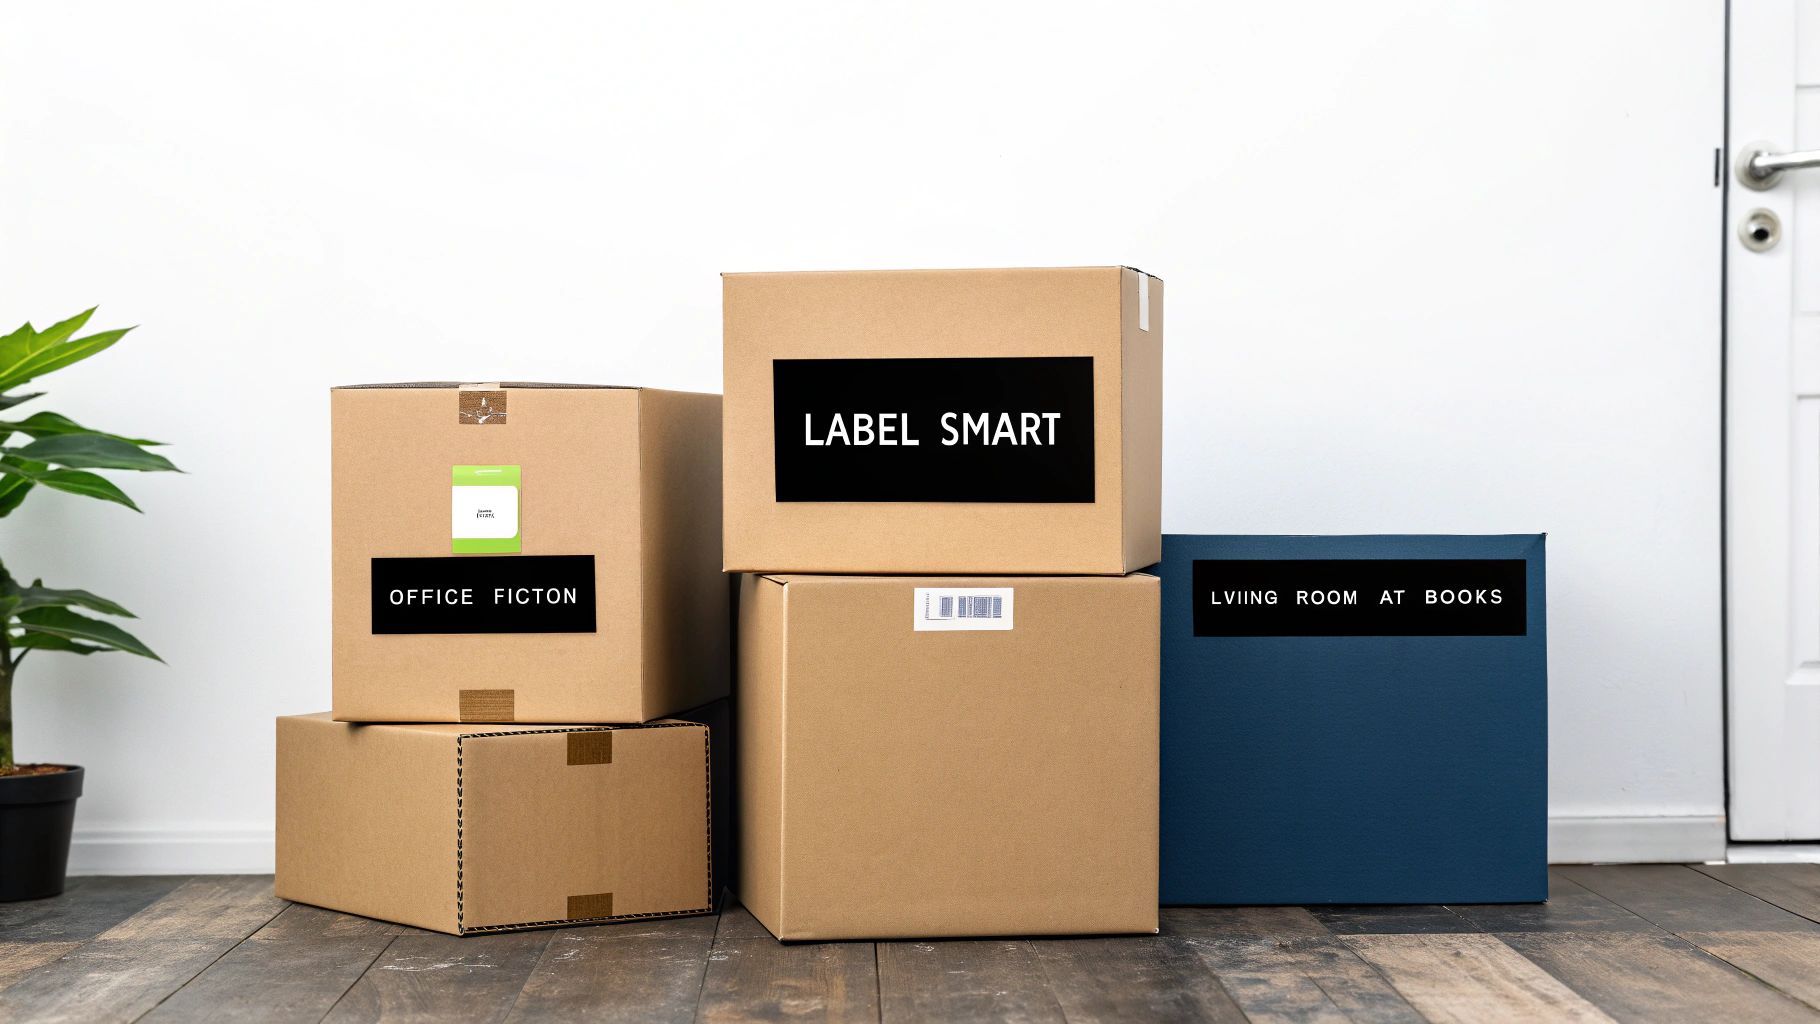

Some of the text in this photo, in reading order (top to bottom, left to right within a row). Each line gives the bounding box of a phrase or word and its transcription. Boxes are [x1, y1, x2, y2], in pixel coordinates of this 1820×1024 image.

[805, 411, 1061, 446] LABEL SMART
[389, 587, 577, 606] OFFICE FICTON
[1211, 588, 1504, 606] LVIING ROOM AT BOOKS
